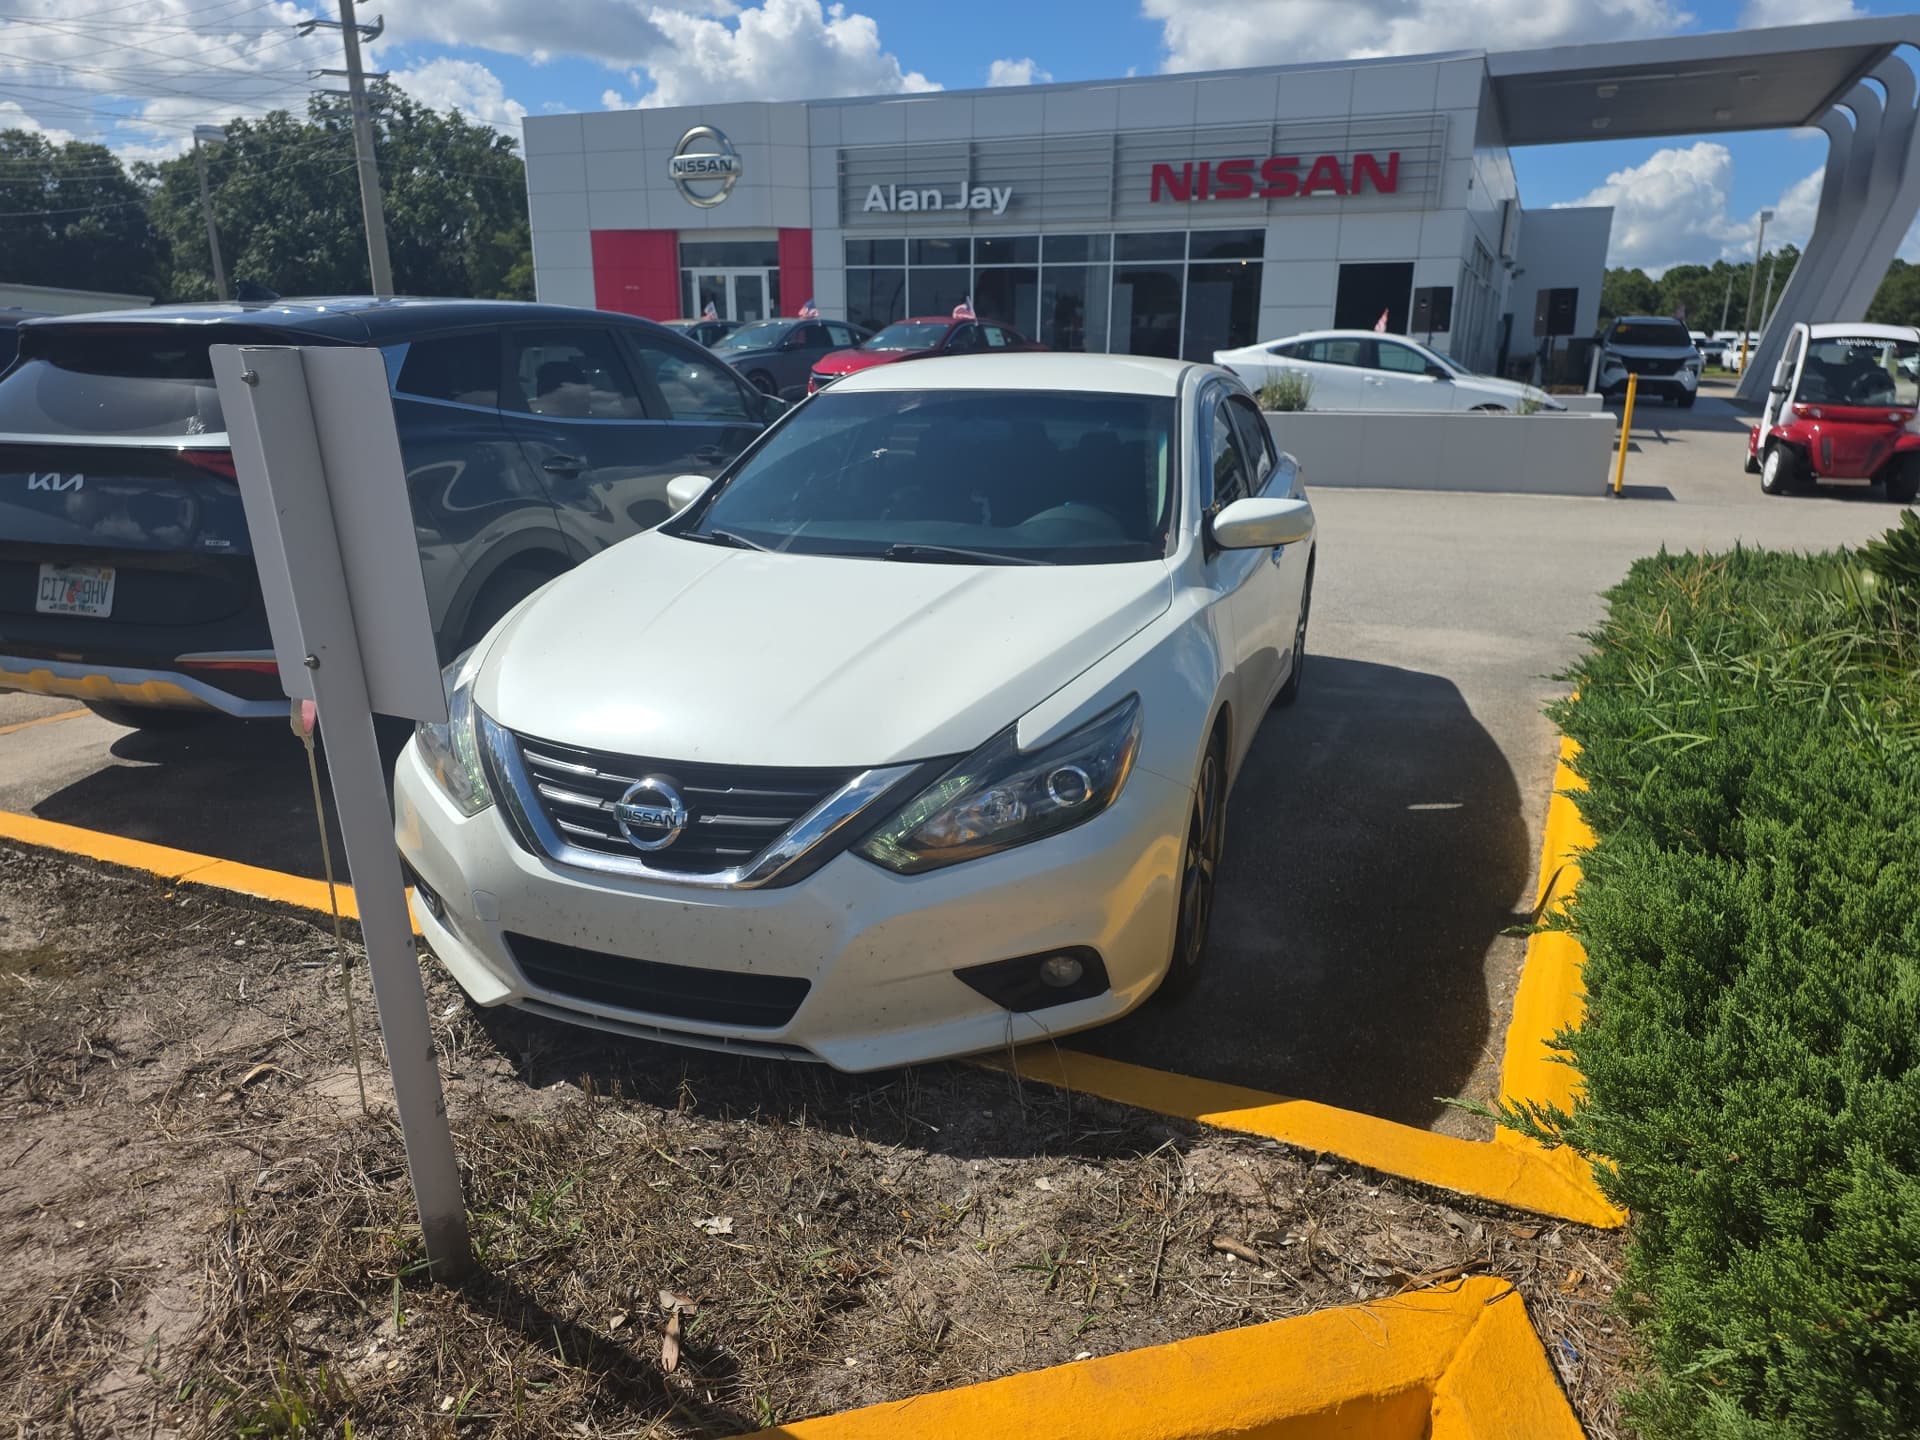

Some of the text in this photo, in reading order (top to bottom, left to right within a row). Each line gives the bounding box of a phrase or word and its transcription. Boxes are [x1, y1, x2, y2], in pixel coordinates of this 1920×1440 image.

[673, 159, 732, 174] NISSAN
[1151, 152, 1399, 203] NISSAN
[863, 181, 1013, 215] Alan Jay
[28, 472, 84, 491] KIA
[619, 807, 678, 825] NISSAN
